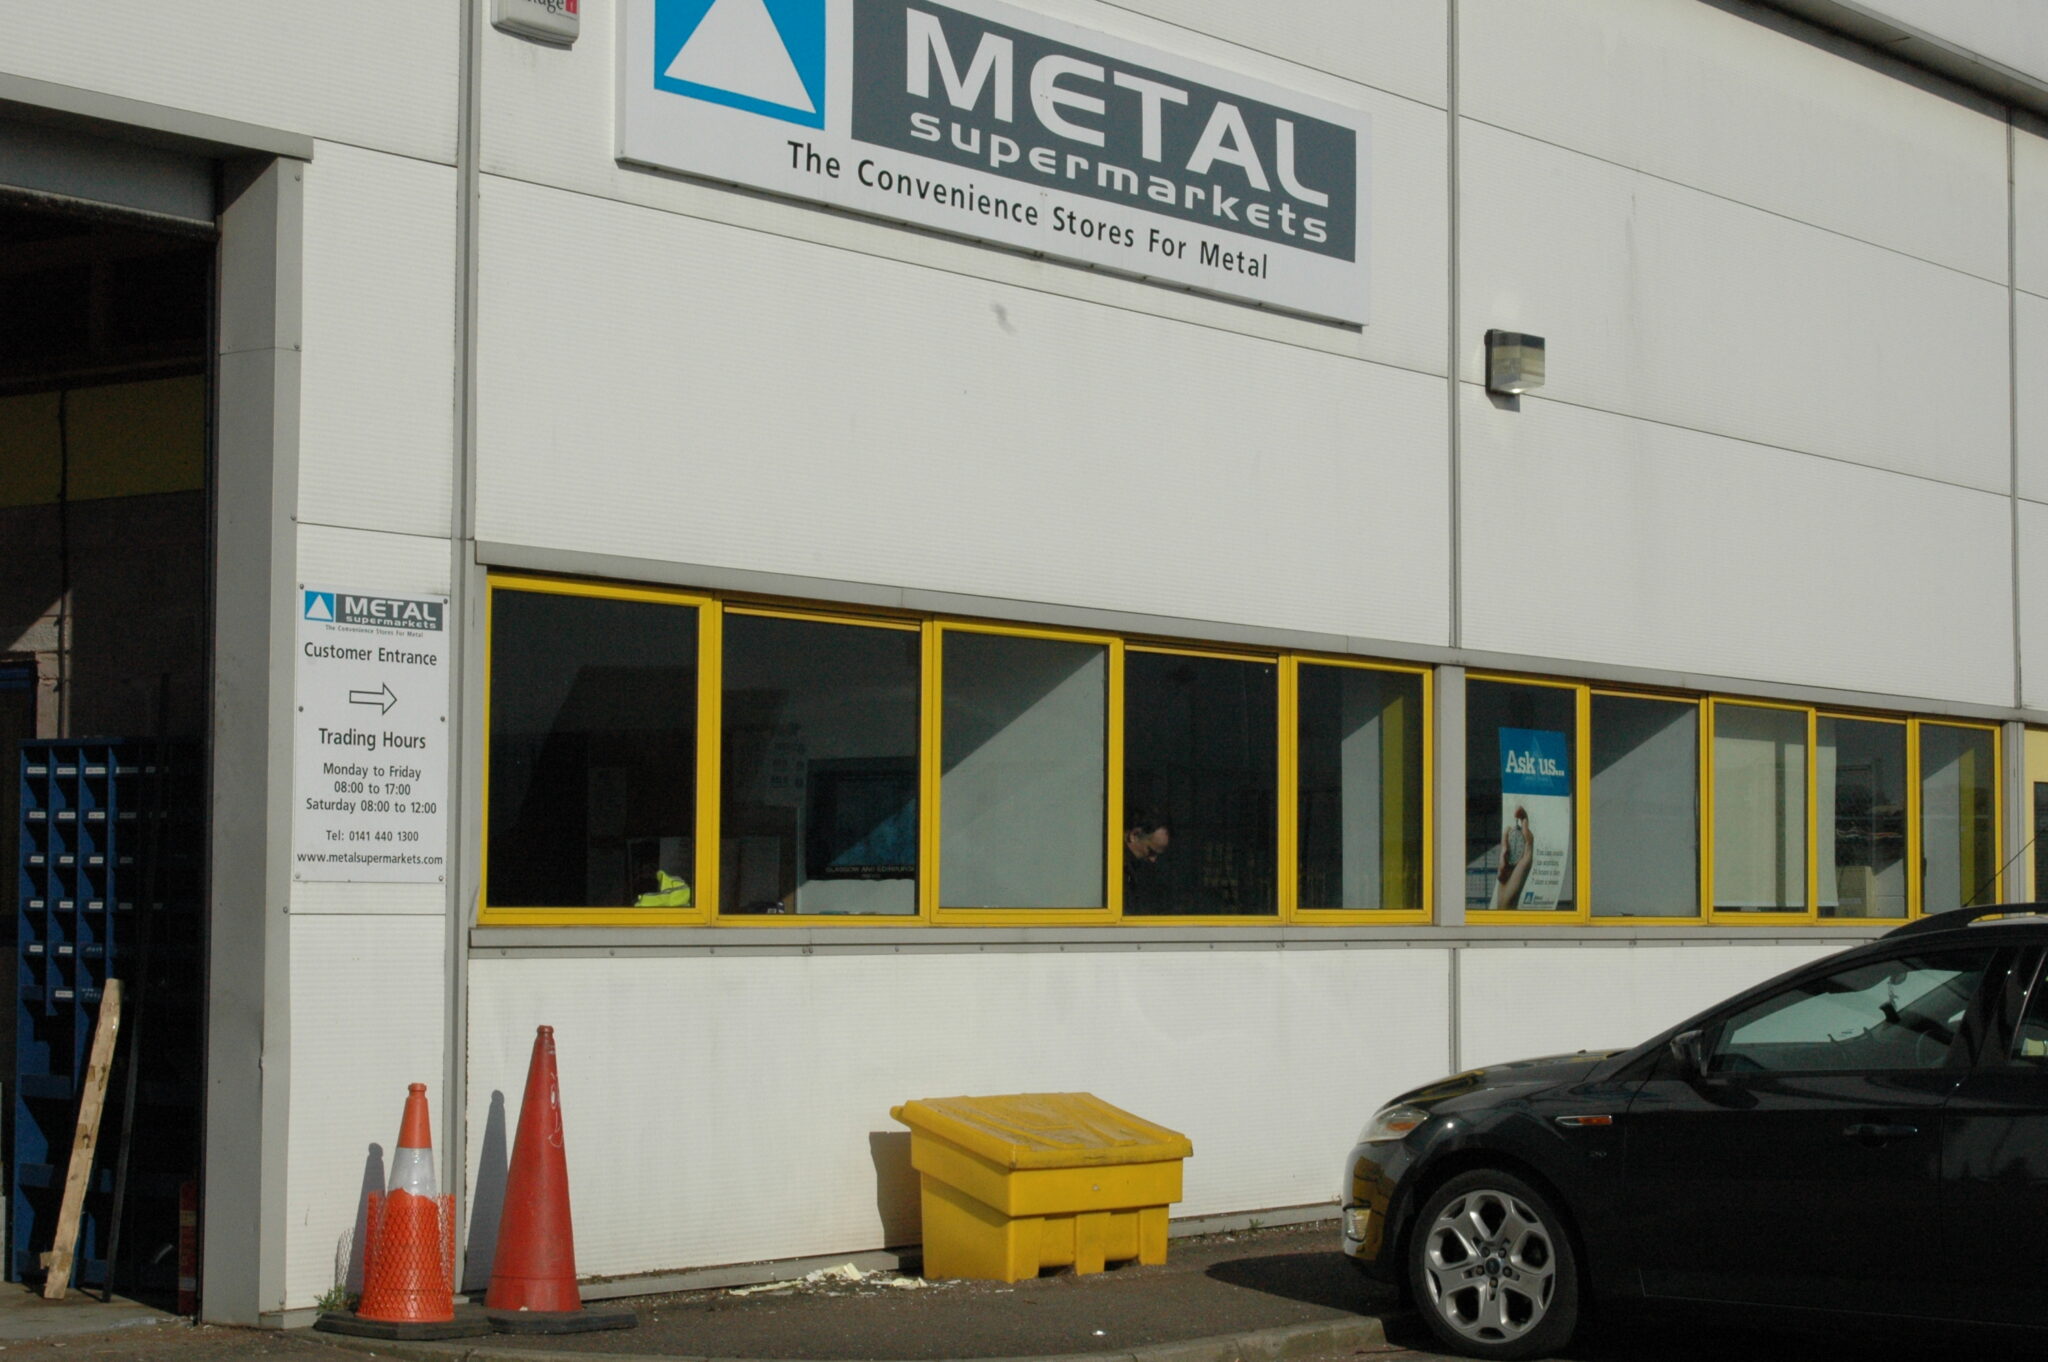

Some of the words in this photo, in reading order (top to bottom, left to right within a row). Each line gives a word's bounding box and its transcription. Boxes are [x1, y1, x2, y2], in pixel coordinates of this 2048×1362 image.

[907, 7, 1328, 208] METAL
[910, 112, 1327, 243] supermarkets
[787, 140, 840, 178] The
[858, 160, 1038, 225] Convenience
[1053, 206, 1134, 247] Stores
[1149, 228, 1186, 259] For
[1200, 240, 1267, 279] Metal
[345, 596, 437, 621] METAL
[345, 615, 437, 629] supermarkets
[304, 641, 373, 661] Customer
[378, 647, 437, 666] Entrance
[318, 727, 376, 751] Trading
[383, 731, 426, 749] Hours
[323, 762, 369, 779] Monday
[373, 765, 385, 777] to
[389, 765, 422, 781] Friday
[1505, 750, 1536, 776] Ask
[1538, 758, 1565, 776] us...
[334, 781, 364, 794] 08:00
[368, 783, 380, 794] to
[385, 783, 411, 795] 17:00
[306, 797, 356, 814] Saturday
[360, 800, 390, 812] 08:00
[395, 802, 406, 813] to
[411, 802, 437, 814] 12:00
[326, 829, 345, 841] Tel:
[349, 831, 371, 841] 0141
[374, 831, 393, 842] 440
[397, 831, 419, 842] 1300
[297, 852, 443, 866] www.metalsupermarkets.com
